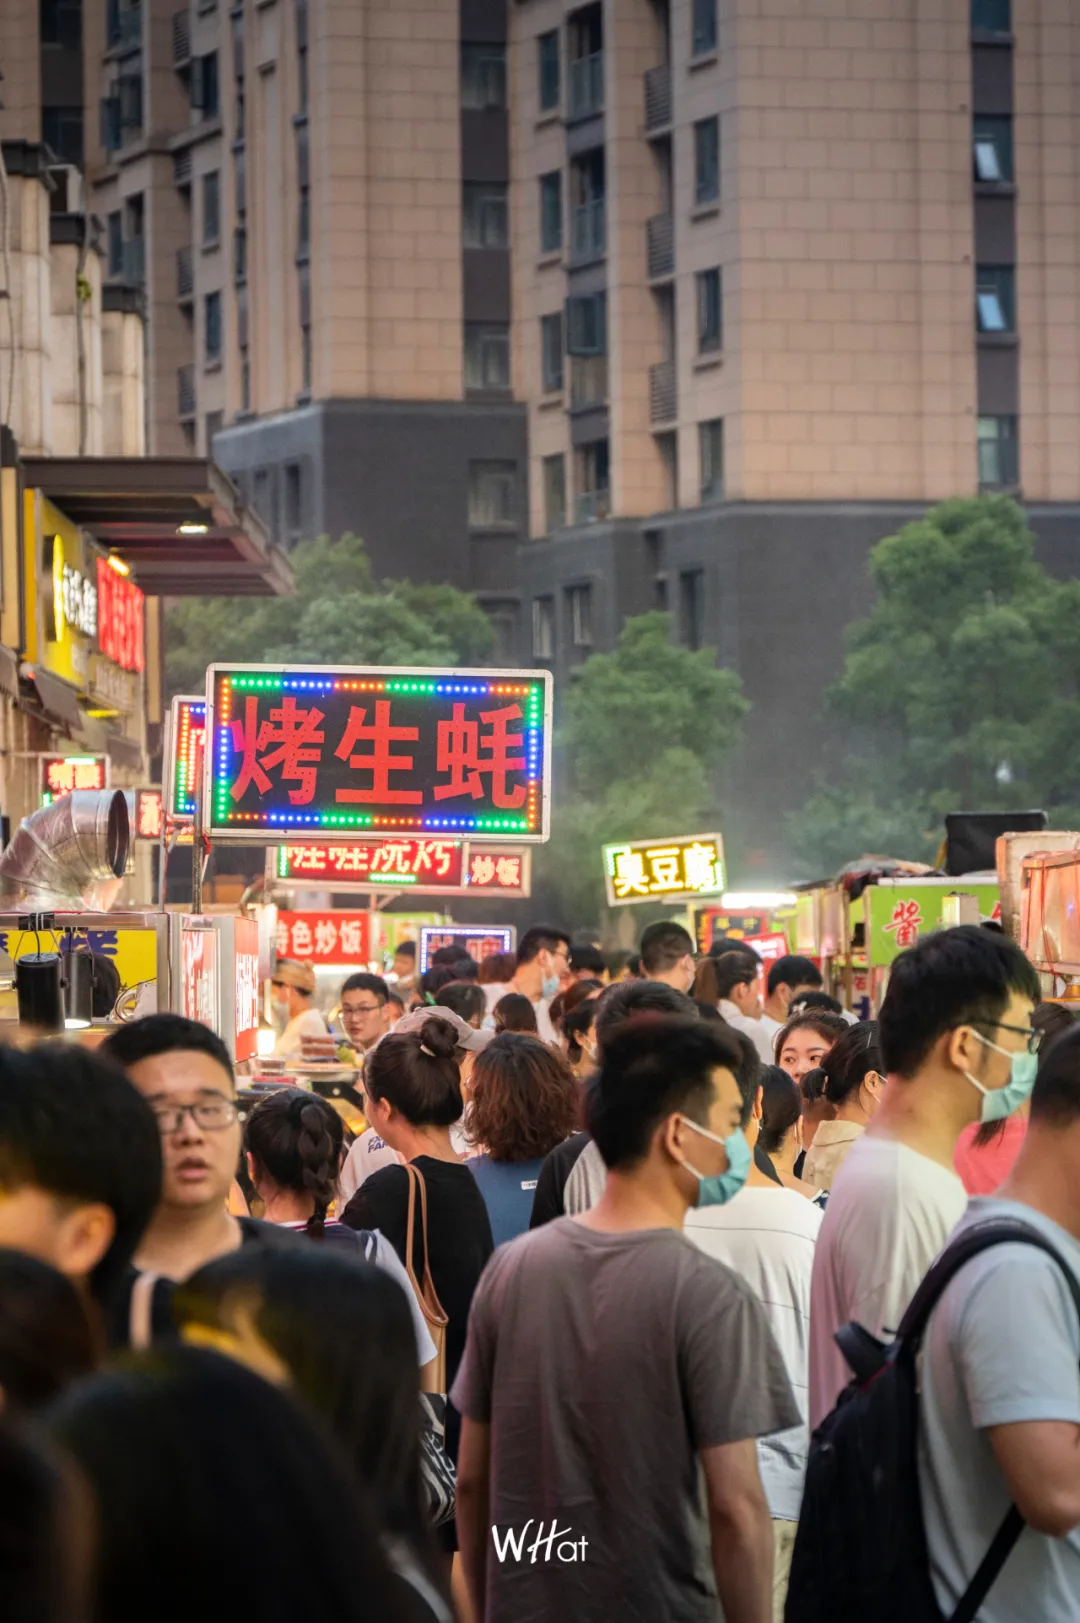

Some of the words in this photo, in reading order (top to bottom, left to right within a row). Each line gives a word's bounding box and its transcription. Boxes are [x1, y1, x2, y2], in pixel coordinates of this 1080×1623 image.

[229, 696, 527, 808] 烤生蚝
[471, 855, 520, 885] 炒饭
[614, 842, 716, 897] 臭豆腐
